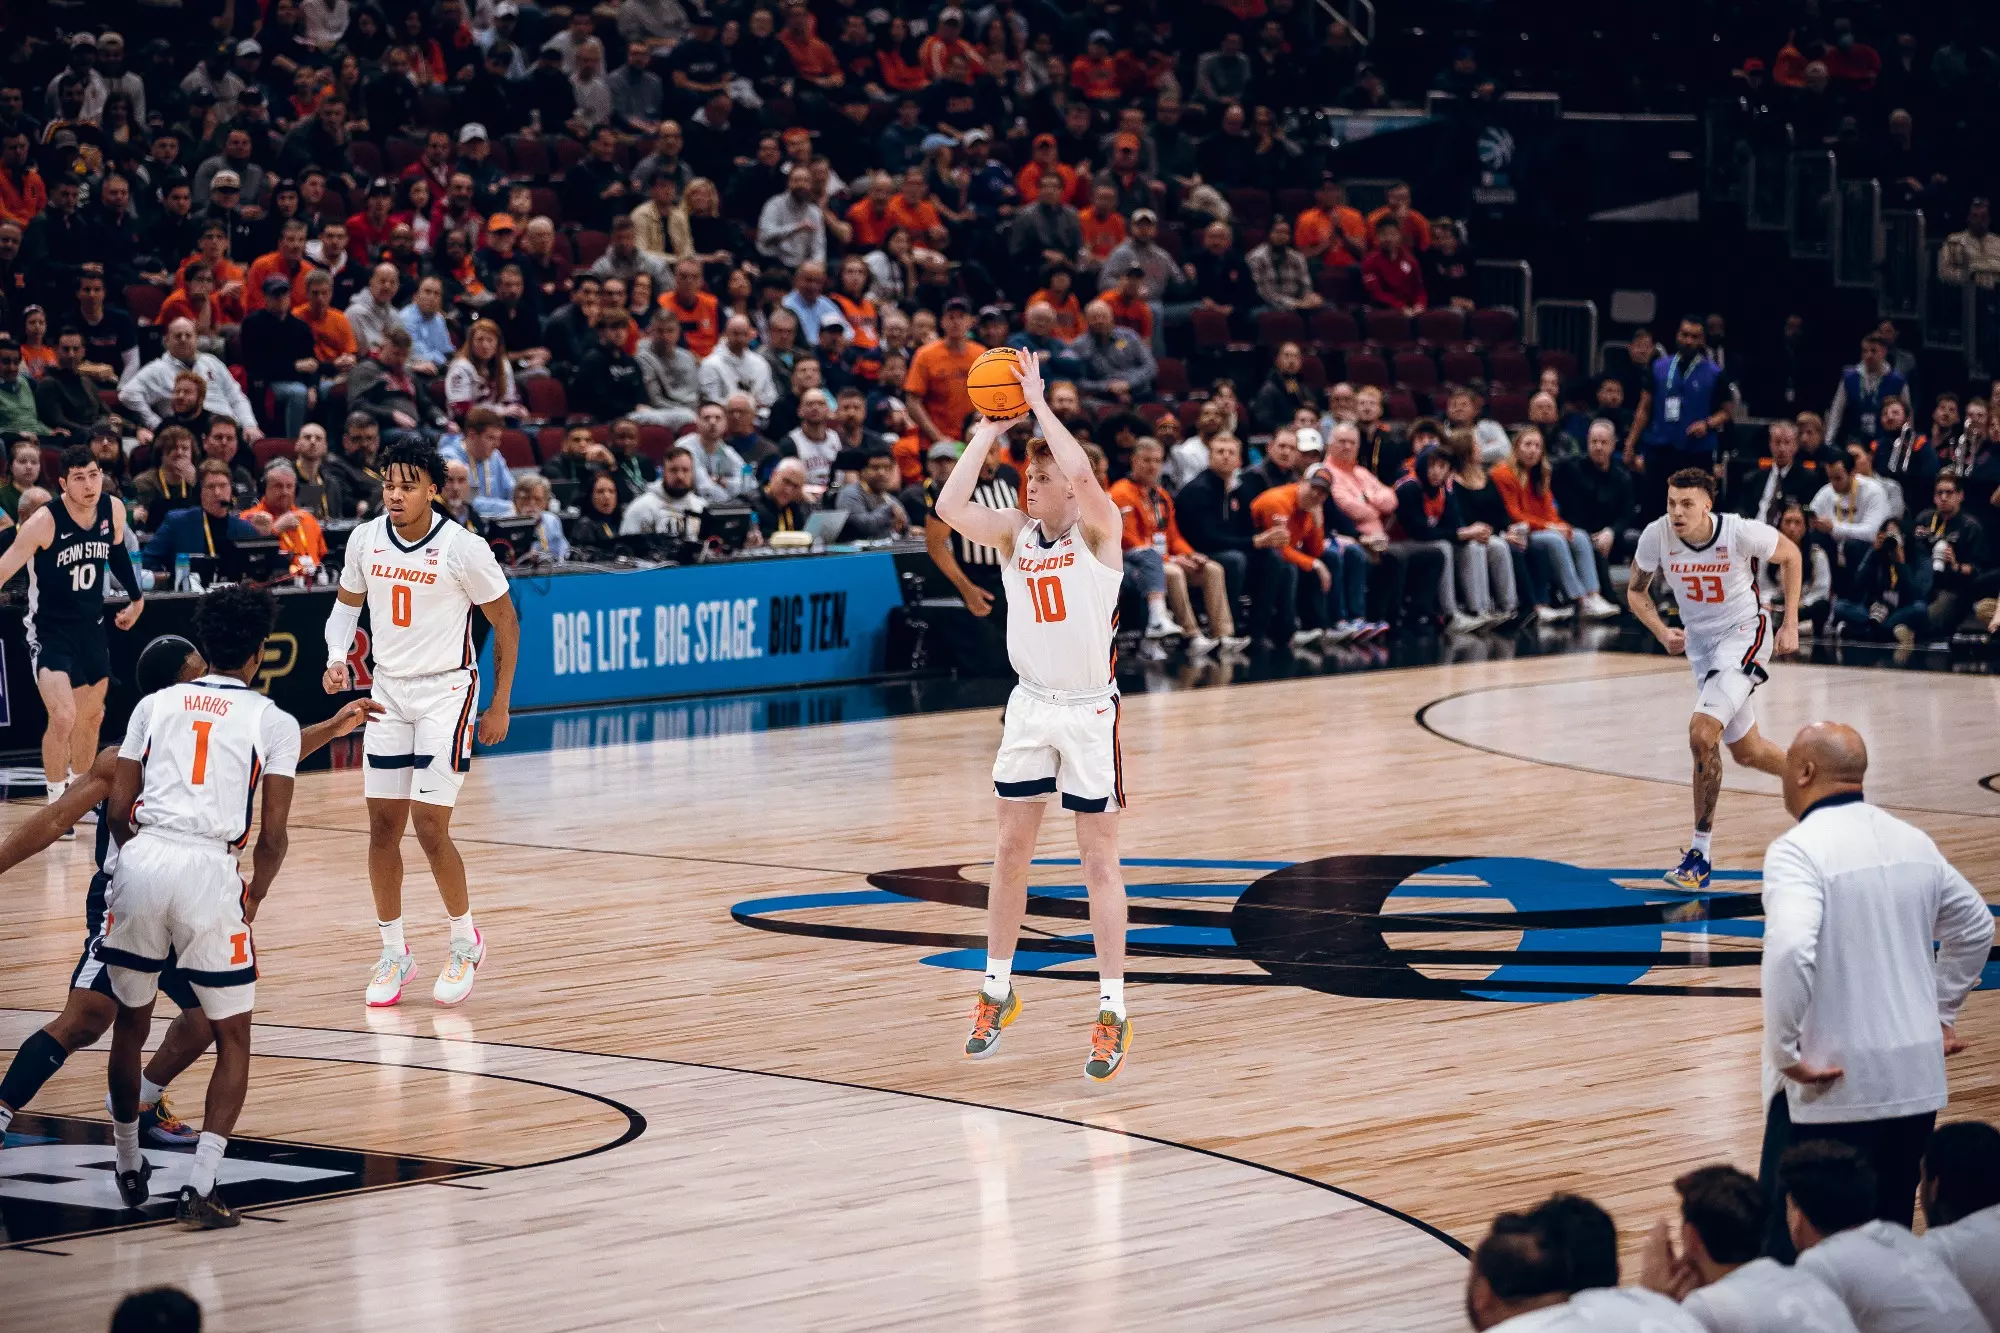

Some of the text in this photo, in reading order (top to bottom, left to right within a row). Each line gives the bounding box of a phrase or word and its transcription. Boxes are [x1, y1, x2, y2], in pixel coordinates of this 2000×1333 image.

[982, 348, 1017, 357] NCAA
[56, 541, 110, 568] PENN STATE
[1670, 562, 1731, 574] ILLINOIS
[69, 563, 97, 592] 10
[370, 564, 438, 585] ILLINOIS
[1026, 575, 1067, 624] 10
[1681, 575, 1725, 604] 33
[391, 584, 412, 628] 0
[552, 591, 849, 676] BIG LIFE. BIG STAGE. BIG TEN.
[184, 695, 233, 717] HARRIS
[191, 720, 213, 785] 1
[230, 932, 248, 965] I
